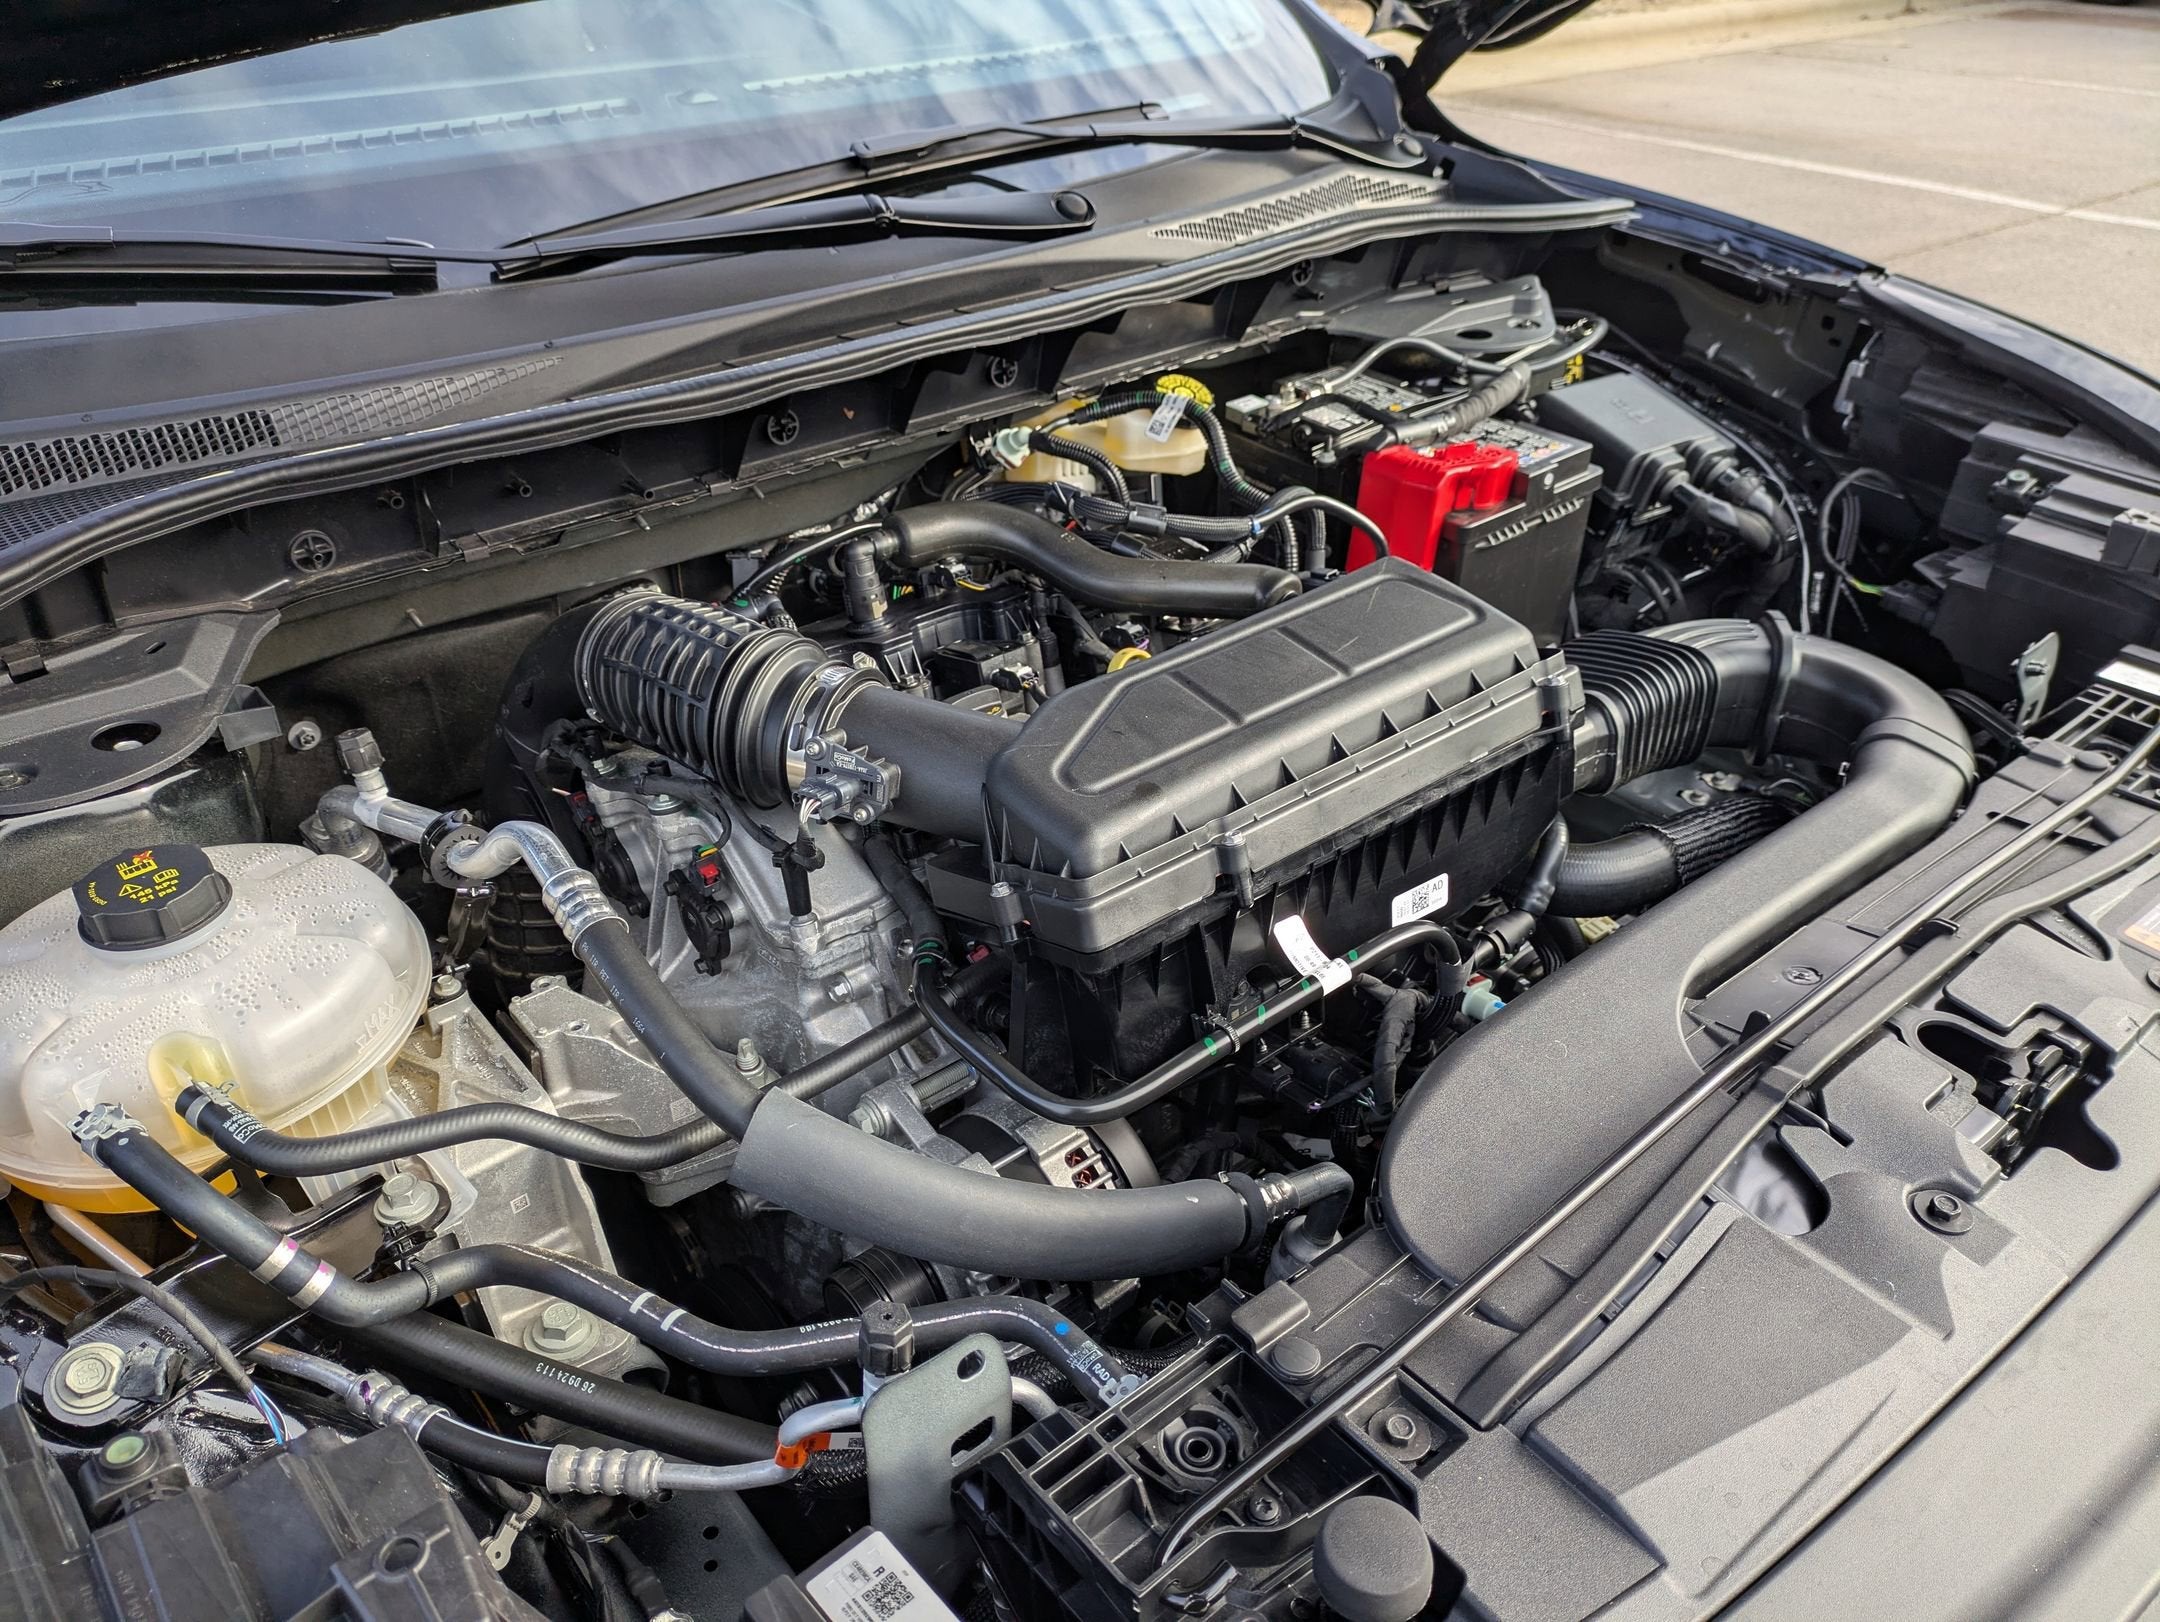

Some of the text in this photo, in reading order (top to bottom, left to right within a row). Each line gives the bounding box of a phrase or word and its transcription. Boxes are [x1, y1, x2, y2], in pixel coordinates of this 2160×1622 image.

[129, 879, 180, 900] 145 kPa
[139, 886, 178, 904] 21 psi
[1431, 879, 1444, 893] AD
[363, 993, 401, 1039] MAX
[1091, 1362, 1111, 1381] RAD
[872, 1565, 886, 1578] R
